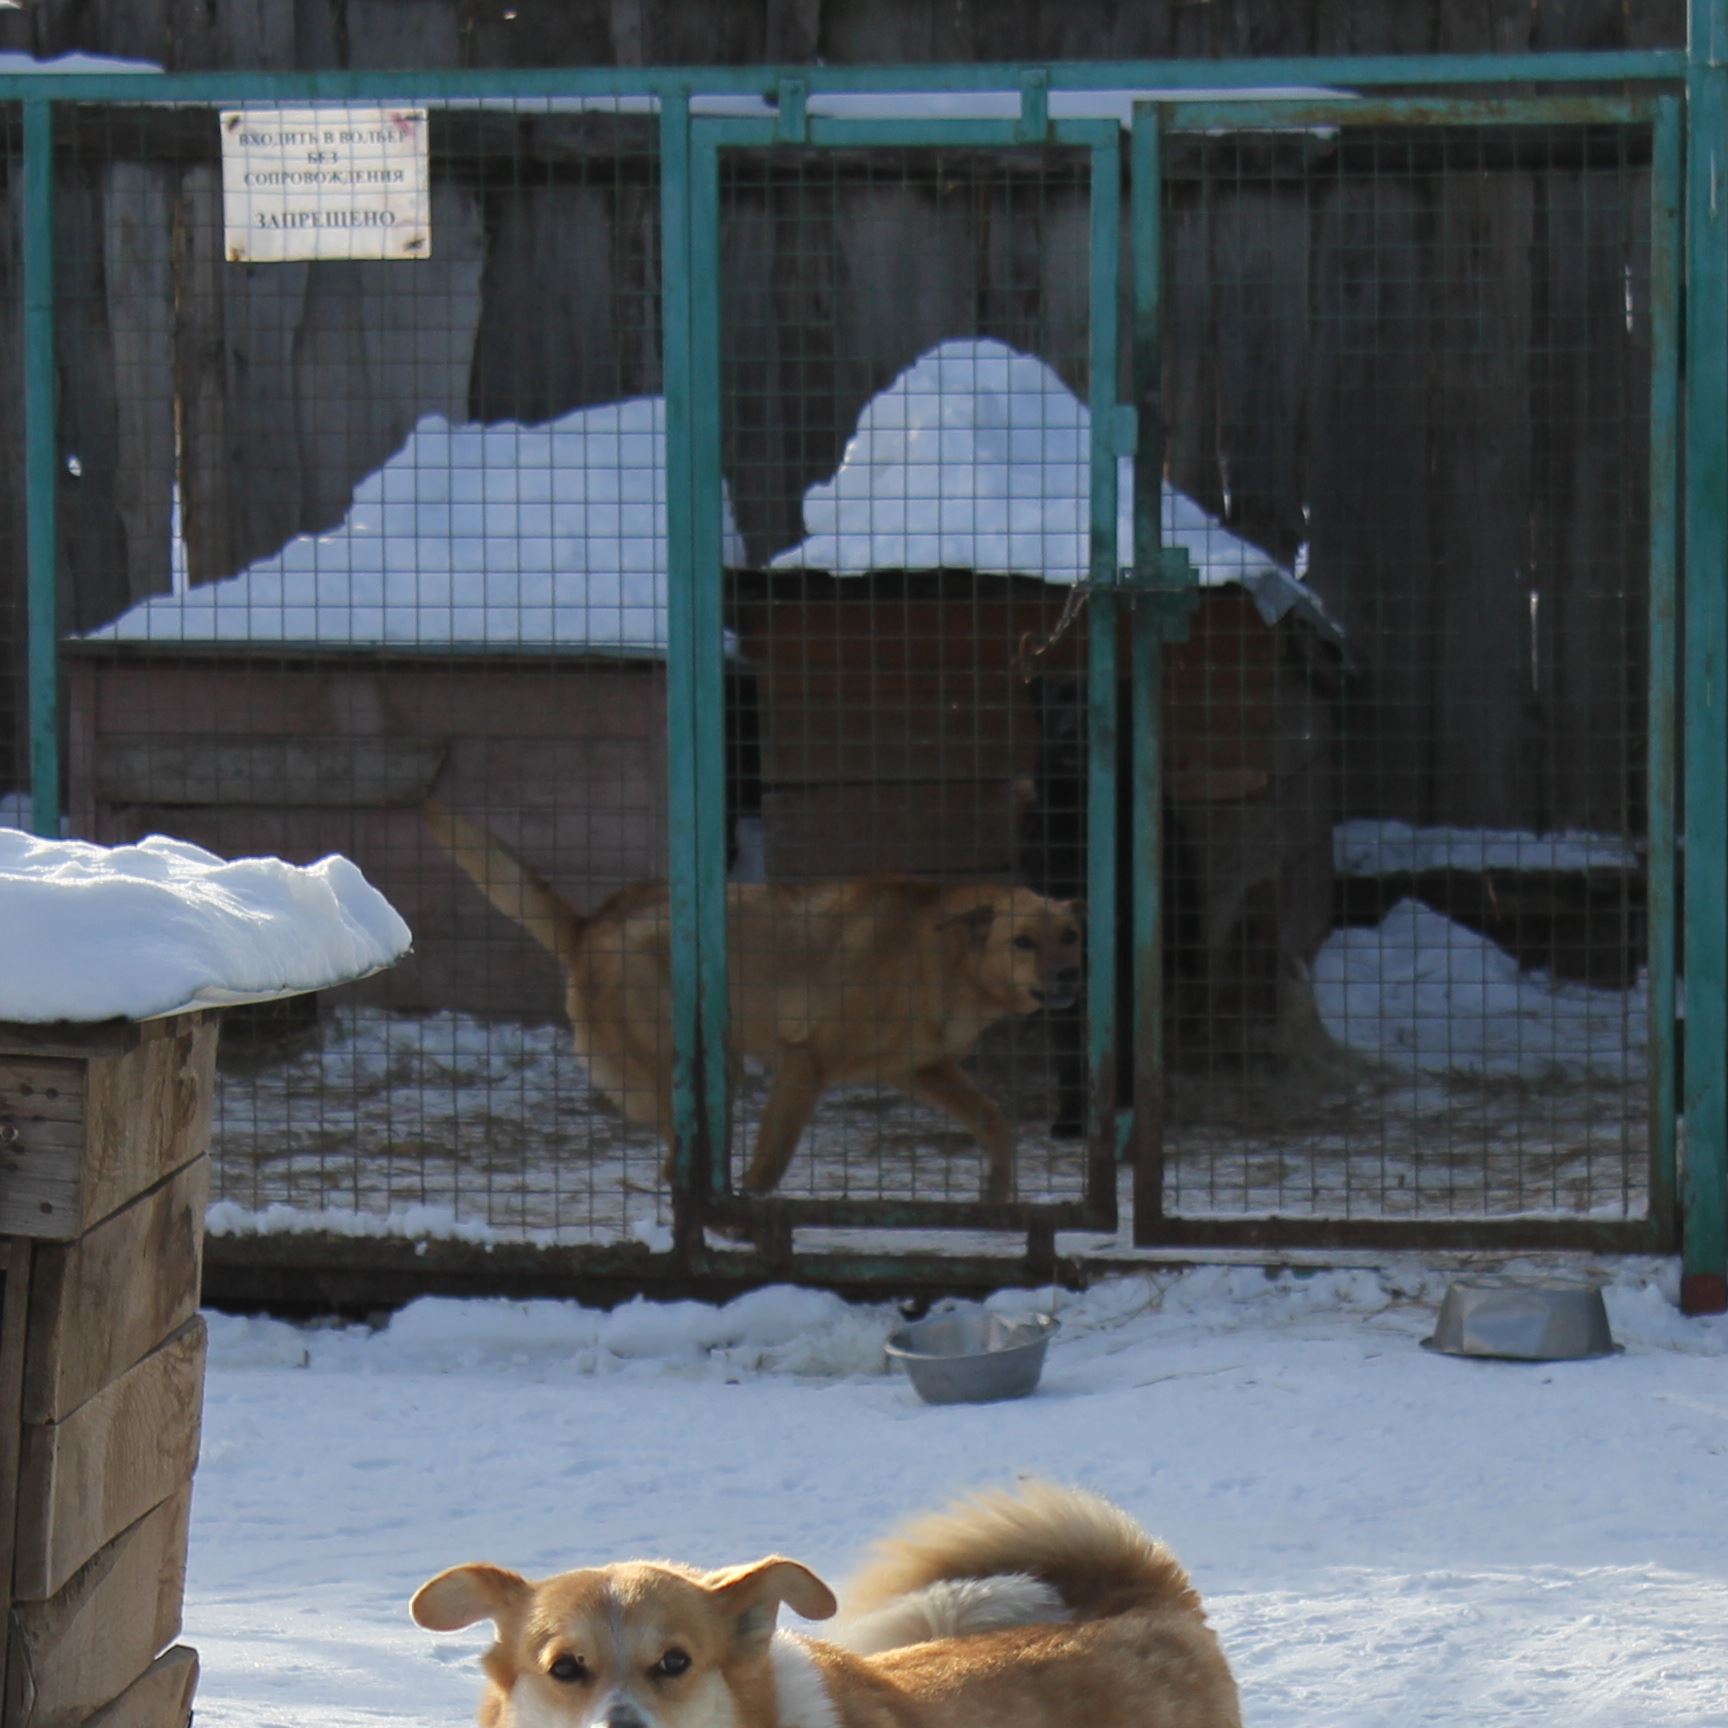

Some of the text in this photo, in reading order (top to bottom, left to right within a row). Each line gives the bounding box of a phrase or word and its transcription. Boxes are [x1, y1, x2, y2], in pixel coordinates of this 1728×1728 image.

[239, 130, 407, 147] ВХОДИТЬ В ВОЛЬЕР
[307, 151, 338, 165] БЕЗ
[244, 170, 404, 186] СОПРОВОЖДЕНИЯ
[256, 211, 396, 229] ЗАПРЕЩЕНО
